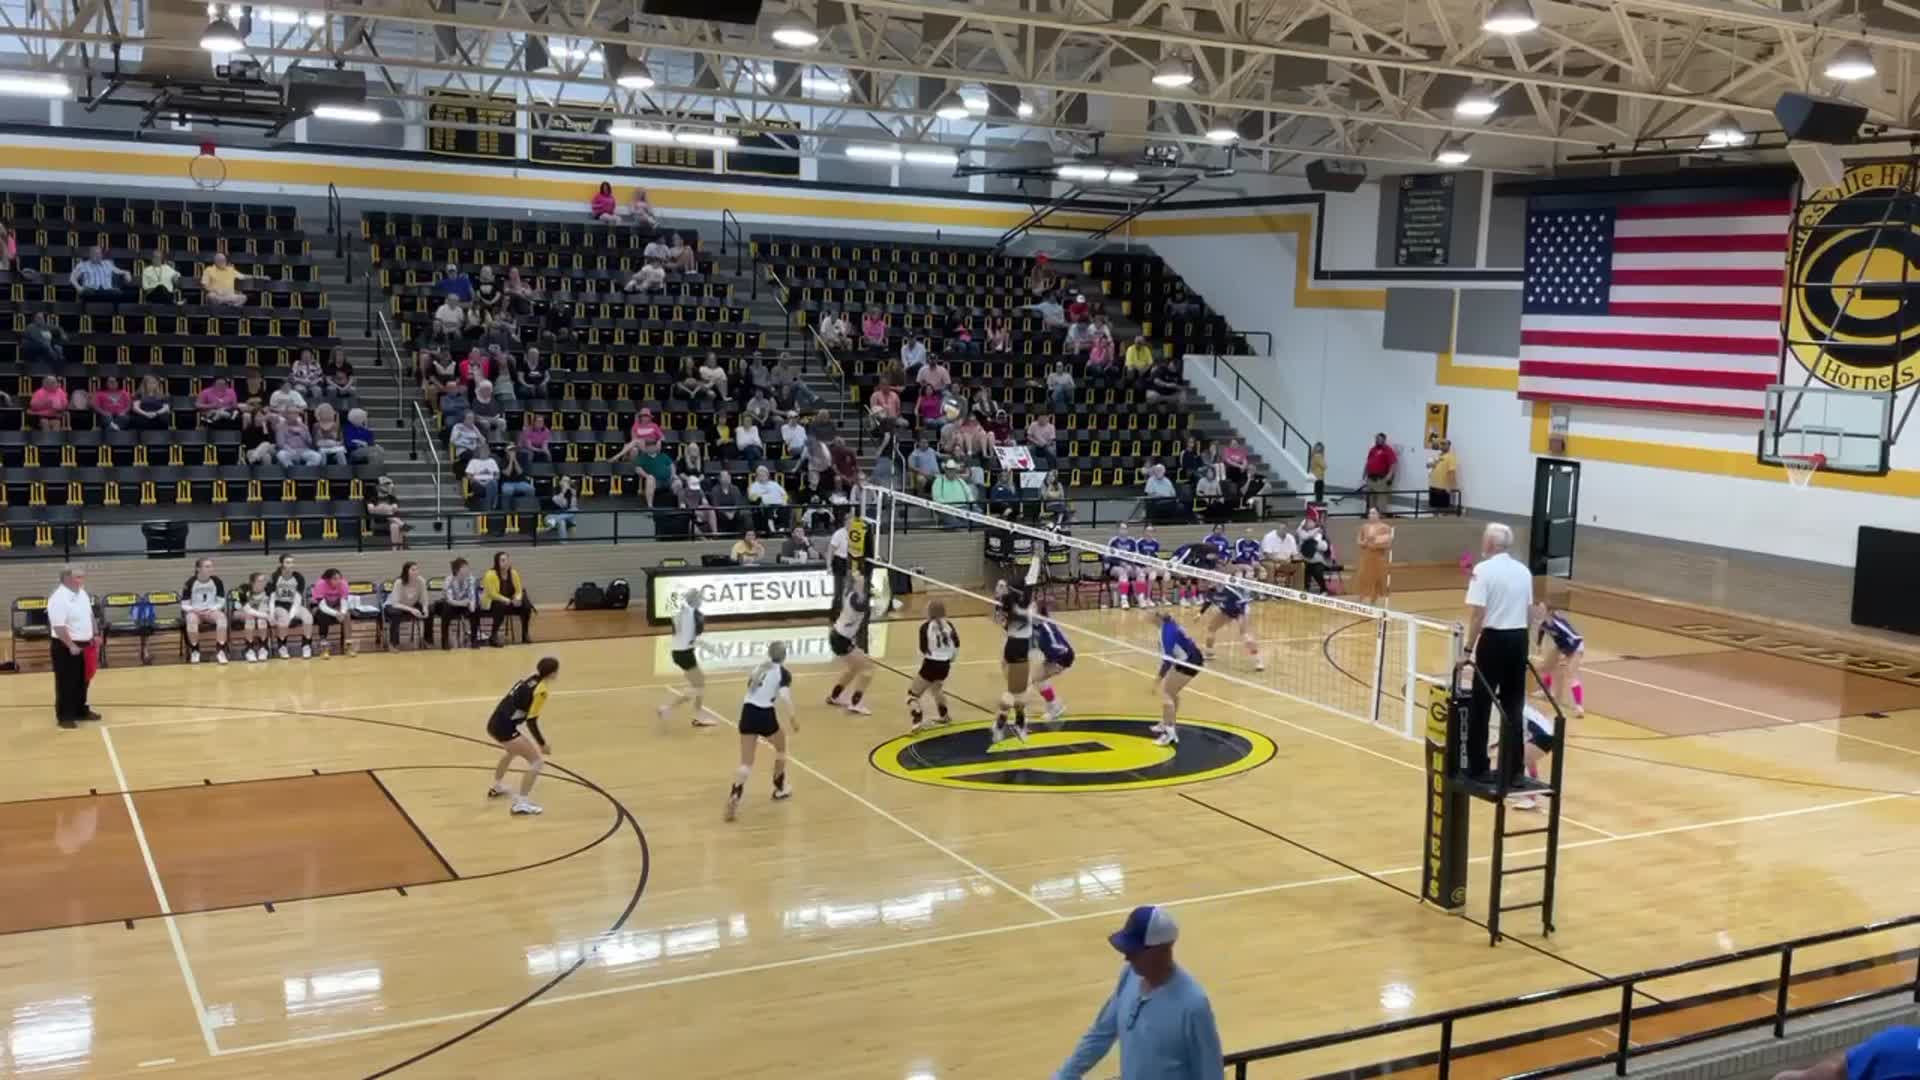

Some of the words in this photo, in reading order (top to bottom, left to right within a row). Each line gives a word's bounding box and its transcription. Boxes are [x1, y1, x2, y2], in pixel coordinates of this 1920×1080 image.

[1821, 360, 1915, 390] Hornes
[849, 529, 861, 542] G
[700, 579, 836, 602] GATESVILL
[1431, 702, 1448, 722] G
